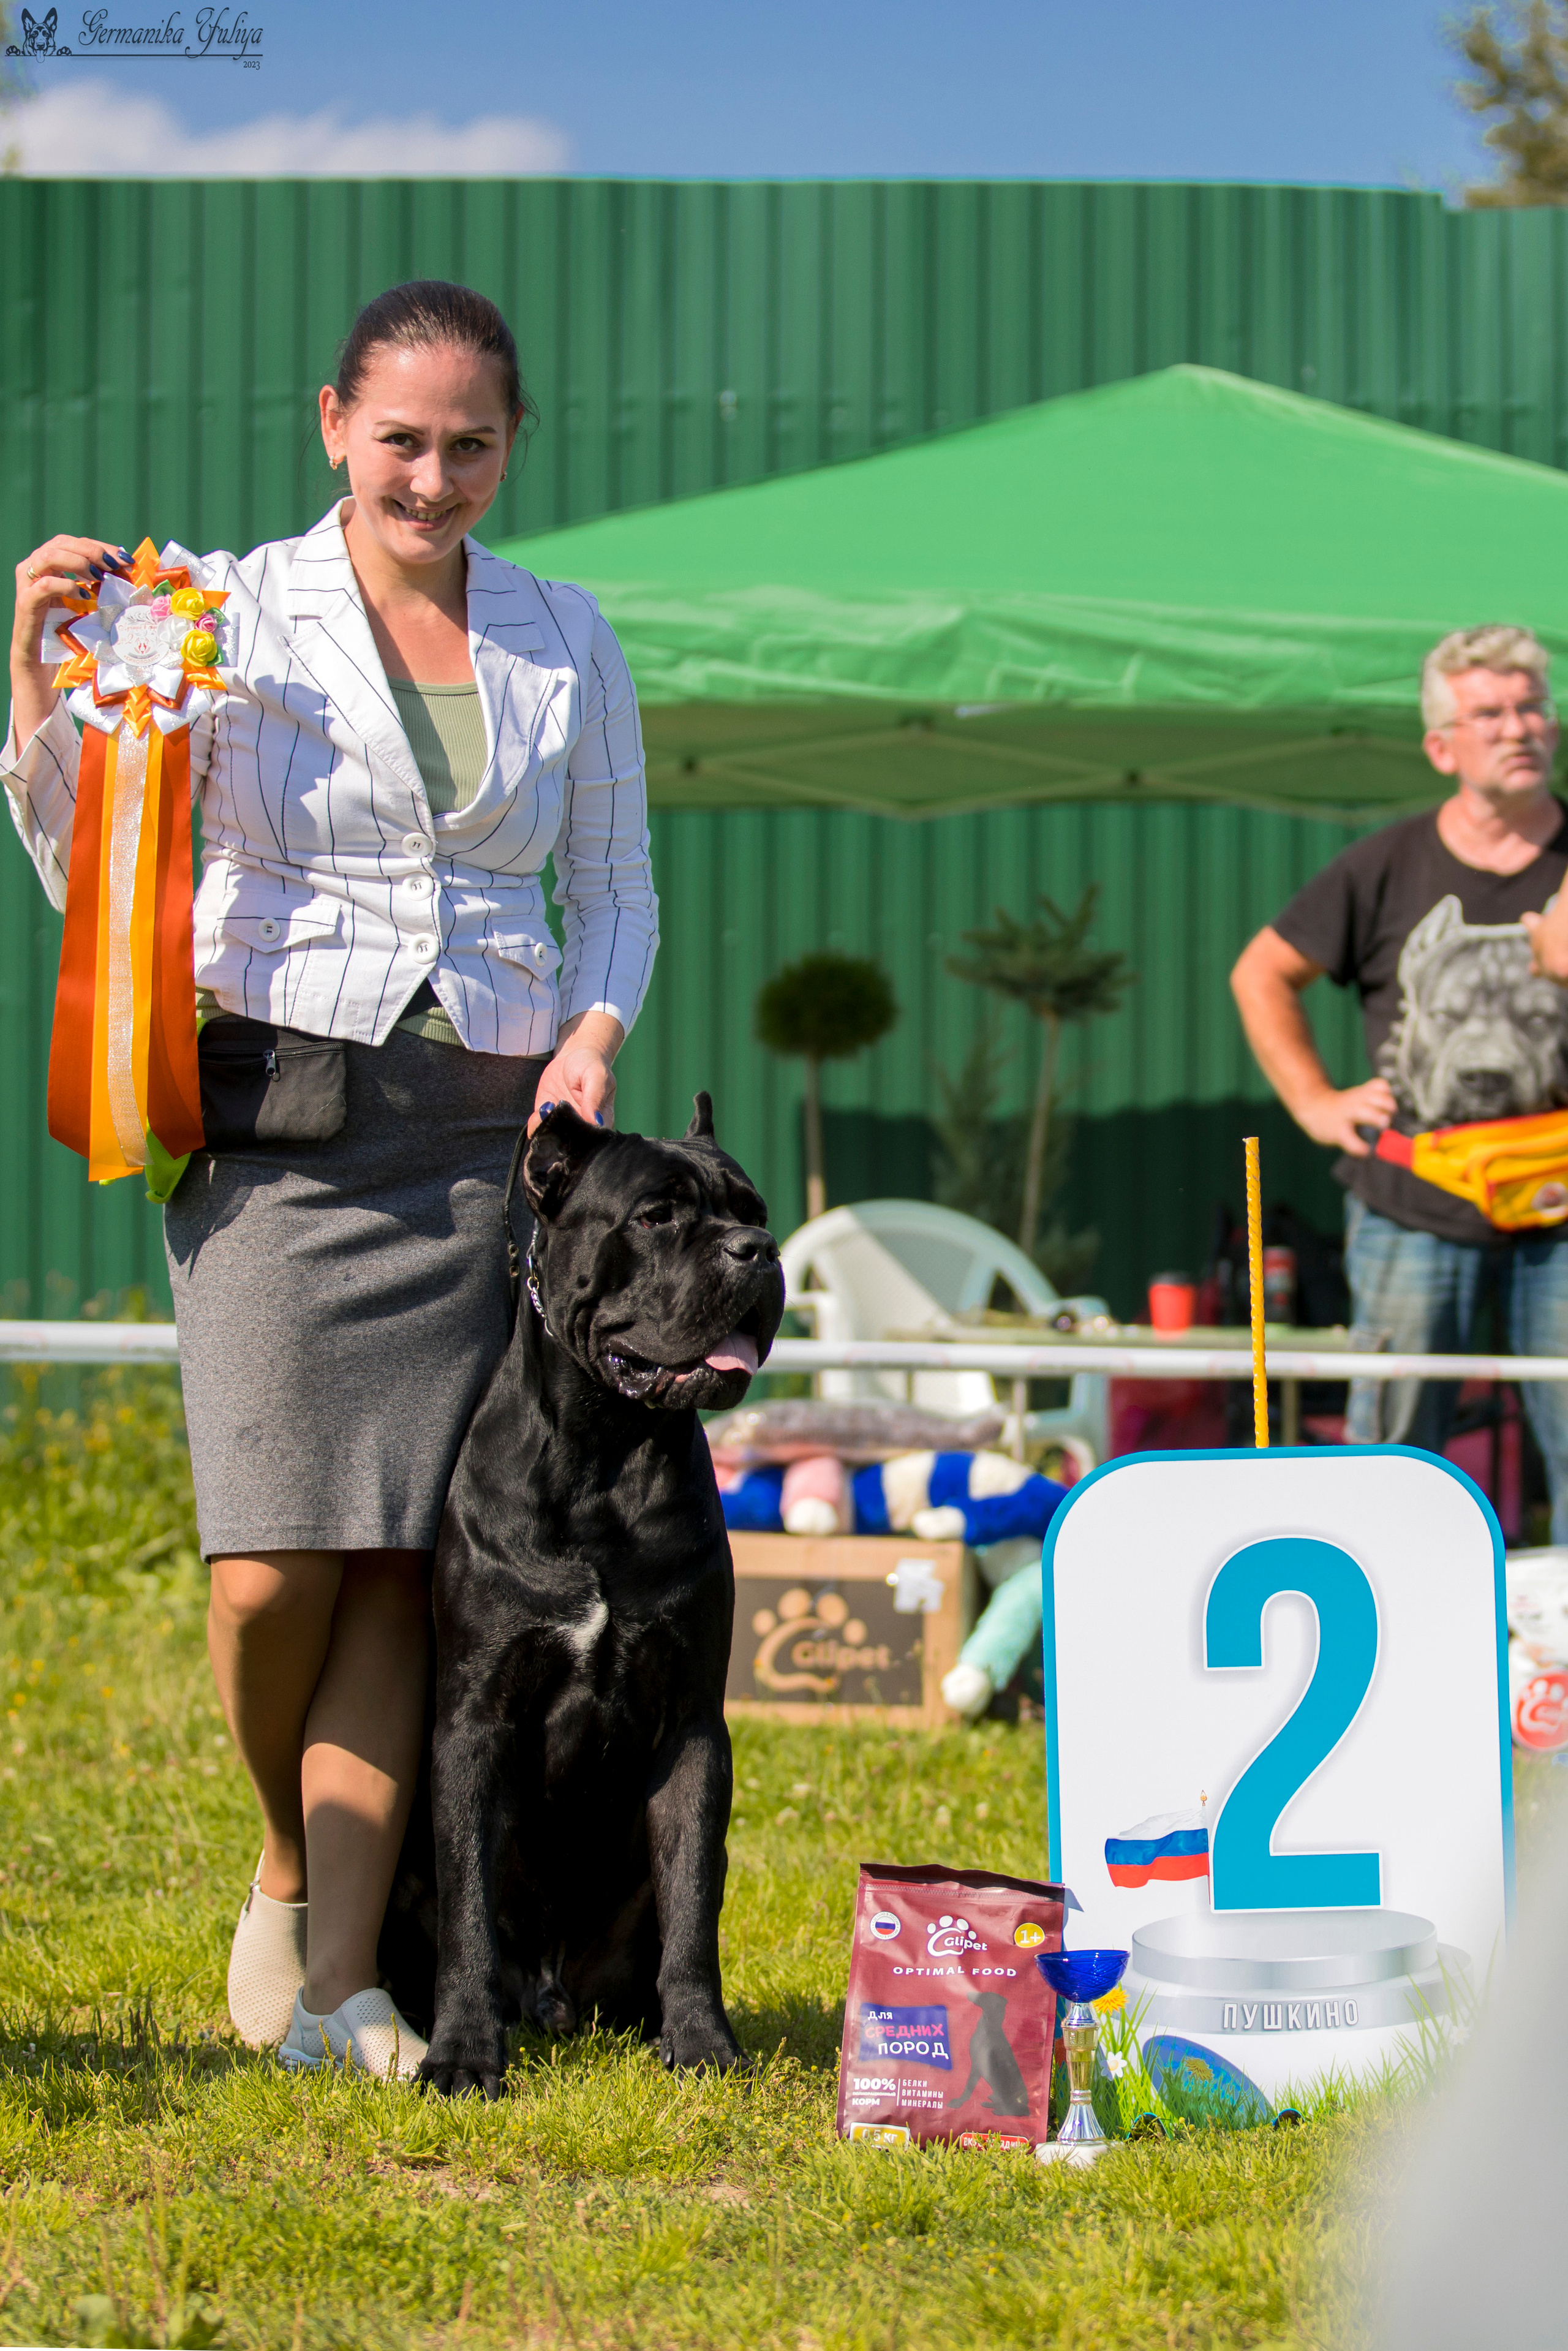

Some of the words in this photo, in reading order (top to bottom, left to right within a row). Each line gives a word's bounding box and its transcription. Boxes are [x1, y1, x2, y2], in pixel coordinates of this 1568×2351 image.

[1204, 1536, 1382, 1911] 2
[944, 1936, 987, 1950] Glipet
[1020, 1930, 1041, 1944] 1+
[893, 1966, 965, 1976] OPTIMAL
[972, 1968, 1017, 1977] FOOD
[1223, 1999, 1359, 2030] ПУШКИНО
[878, 2041, 949, 2059] ПОРОД
[853, 2078, 896, 2091] 100%
[902, 2079, 927, 2088] БЕЛКИ
[902, 2089, 943, 2099] ВИТАМИНЫ
[901, 2099, 943, 2109] МИНЕРАЛЫ
